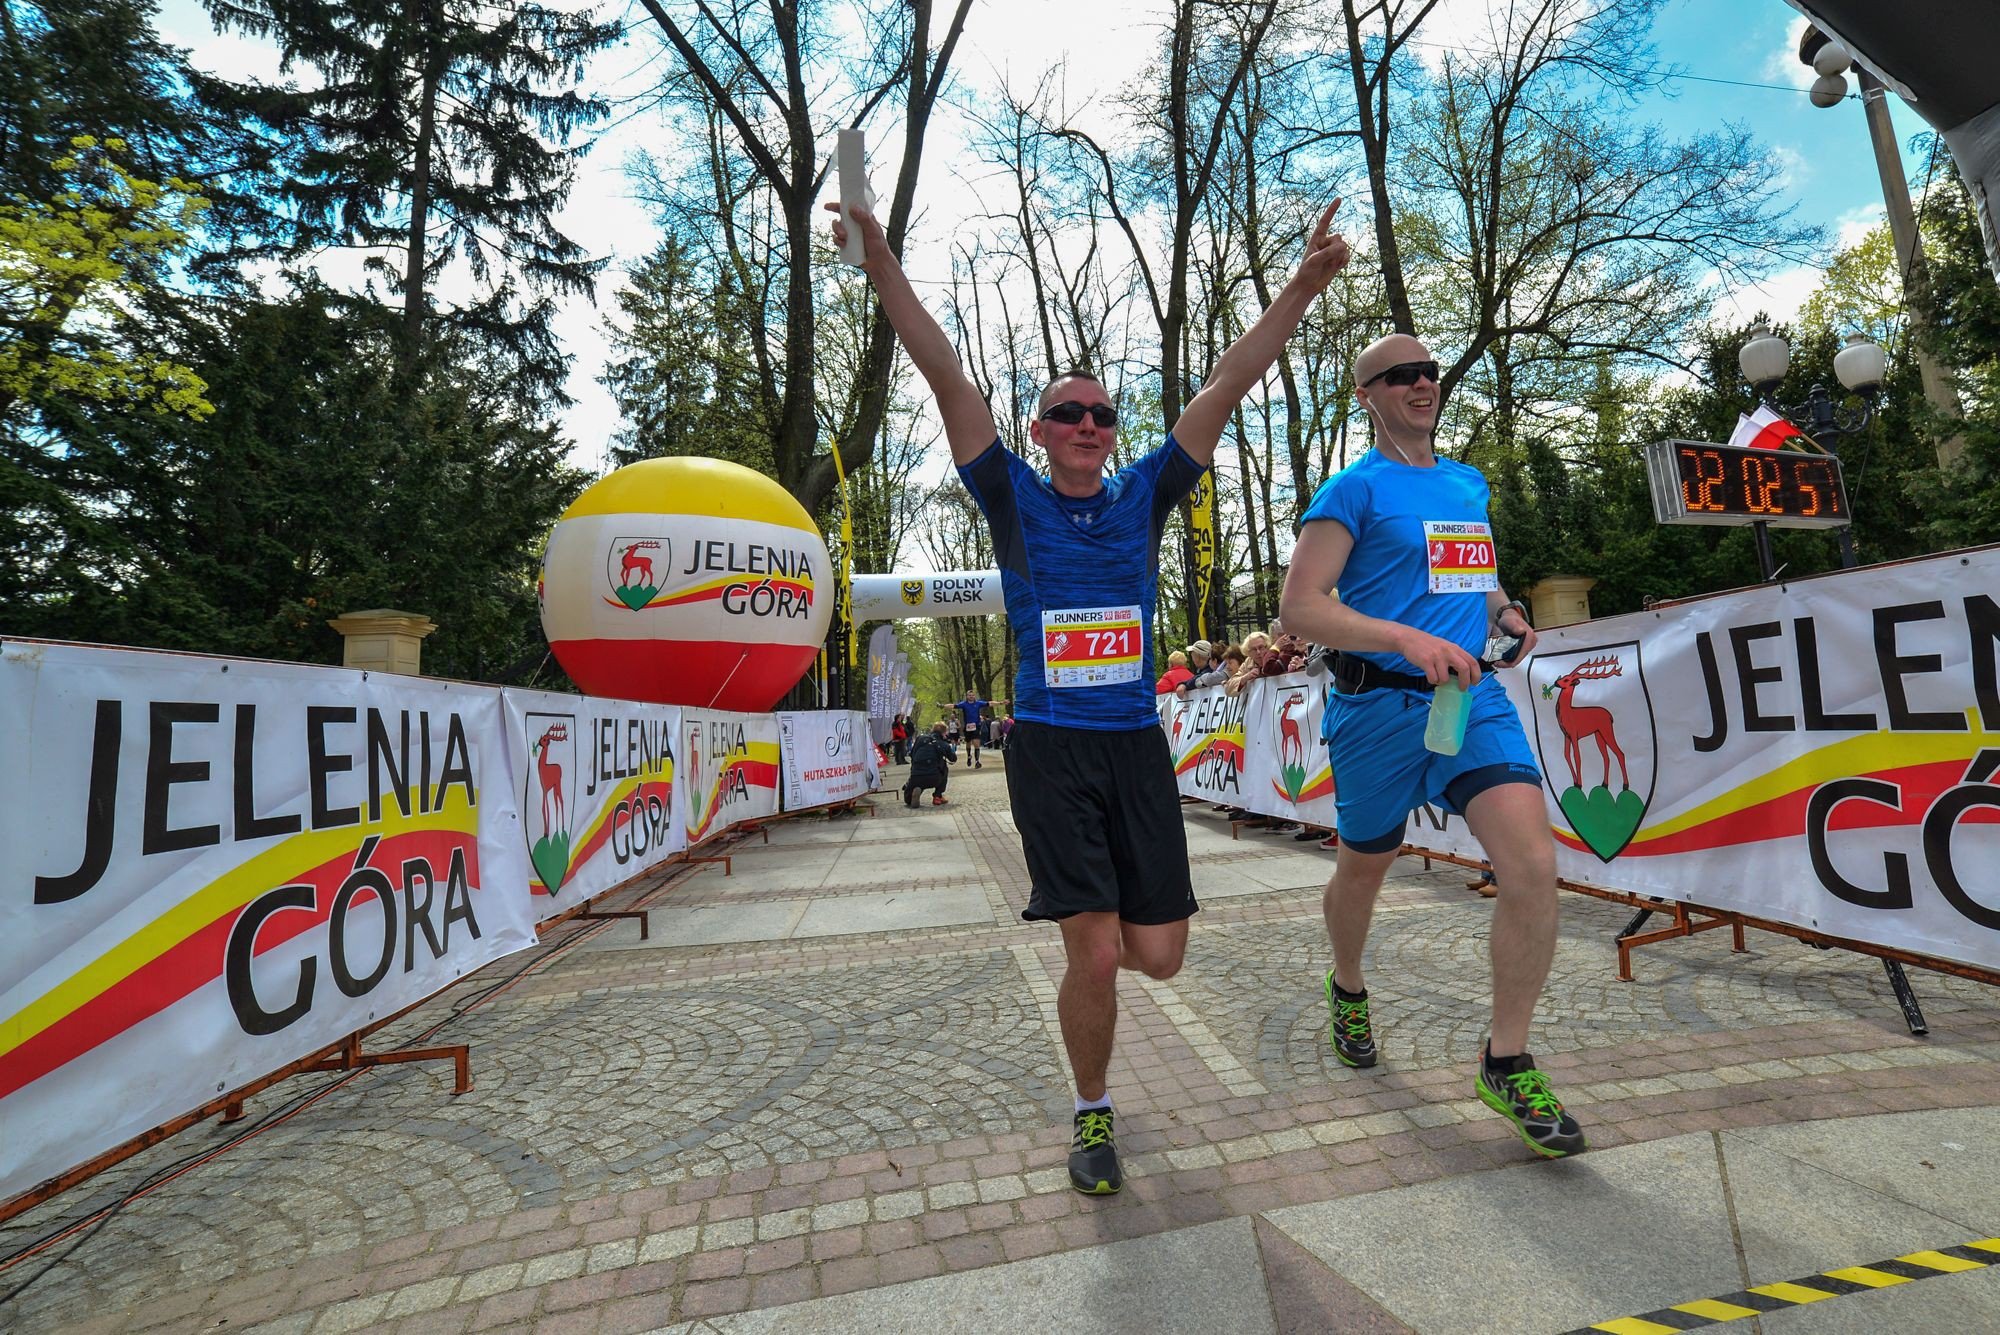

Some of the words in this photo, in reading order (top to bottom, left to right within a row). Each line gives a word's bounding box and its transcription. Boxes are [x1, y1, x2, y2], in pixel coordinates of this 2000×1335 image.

[683, 540, 813, 581] JELENIA
[1455, 543, 1489, 565] 720
[722, 578, 808, 620] GÓRA
[933, 578, 986, 590] DOLNY
[933, 588, 983, 604] ŚLĄSK
[1085, 630, 1129, 656] 721
[871, 675, 880, 719] REGATTA
[1187, 693, 1249, 740] JELENIA
[586, 717, 675, 796] JELENIA
[804, 769, 825, 782] HUTA
[825, 766, 848, 779] SZKŁA
[34, 699, 477, 905] JELENIA
[611, 783, 673, 865] GÓRA
[226, 835, 482, 1036] GÓRA
